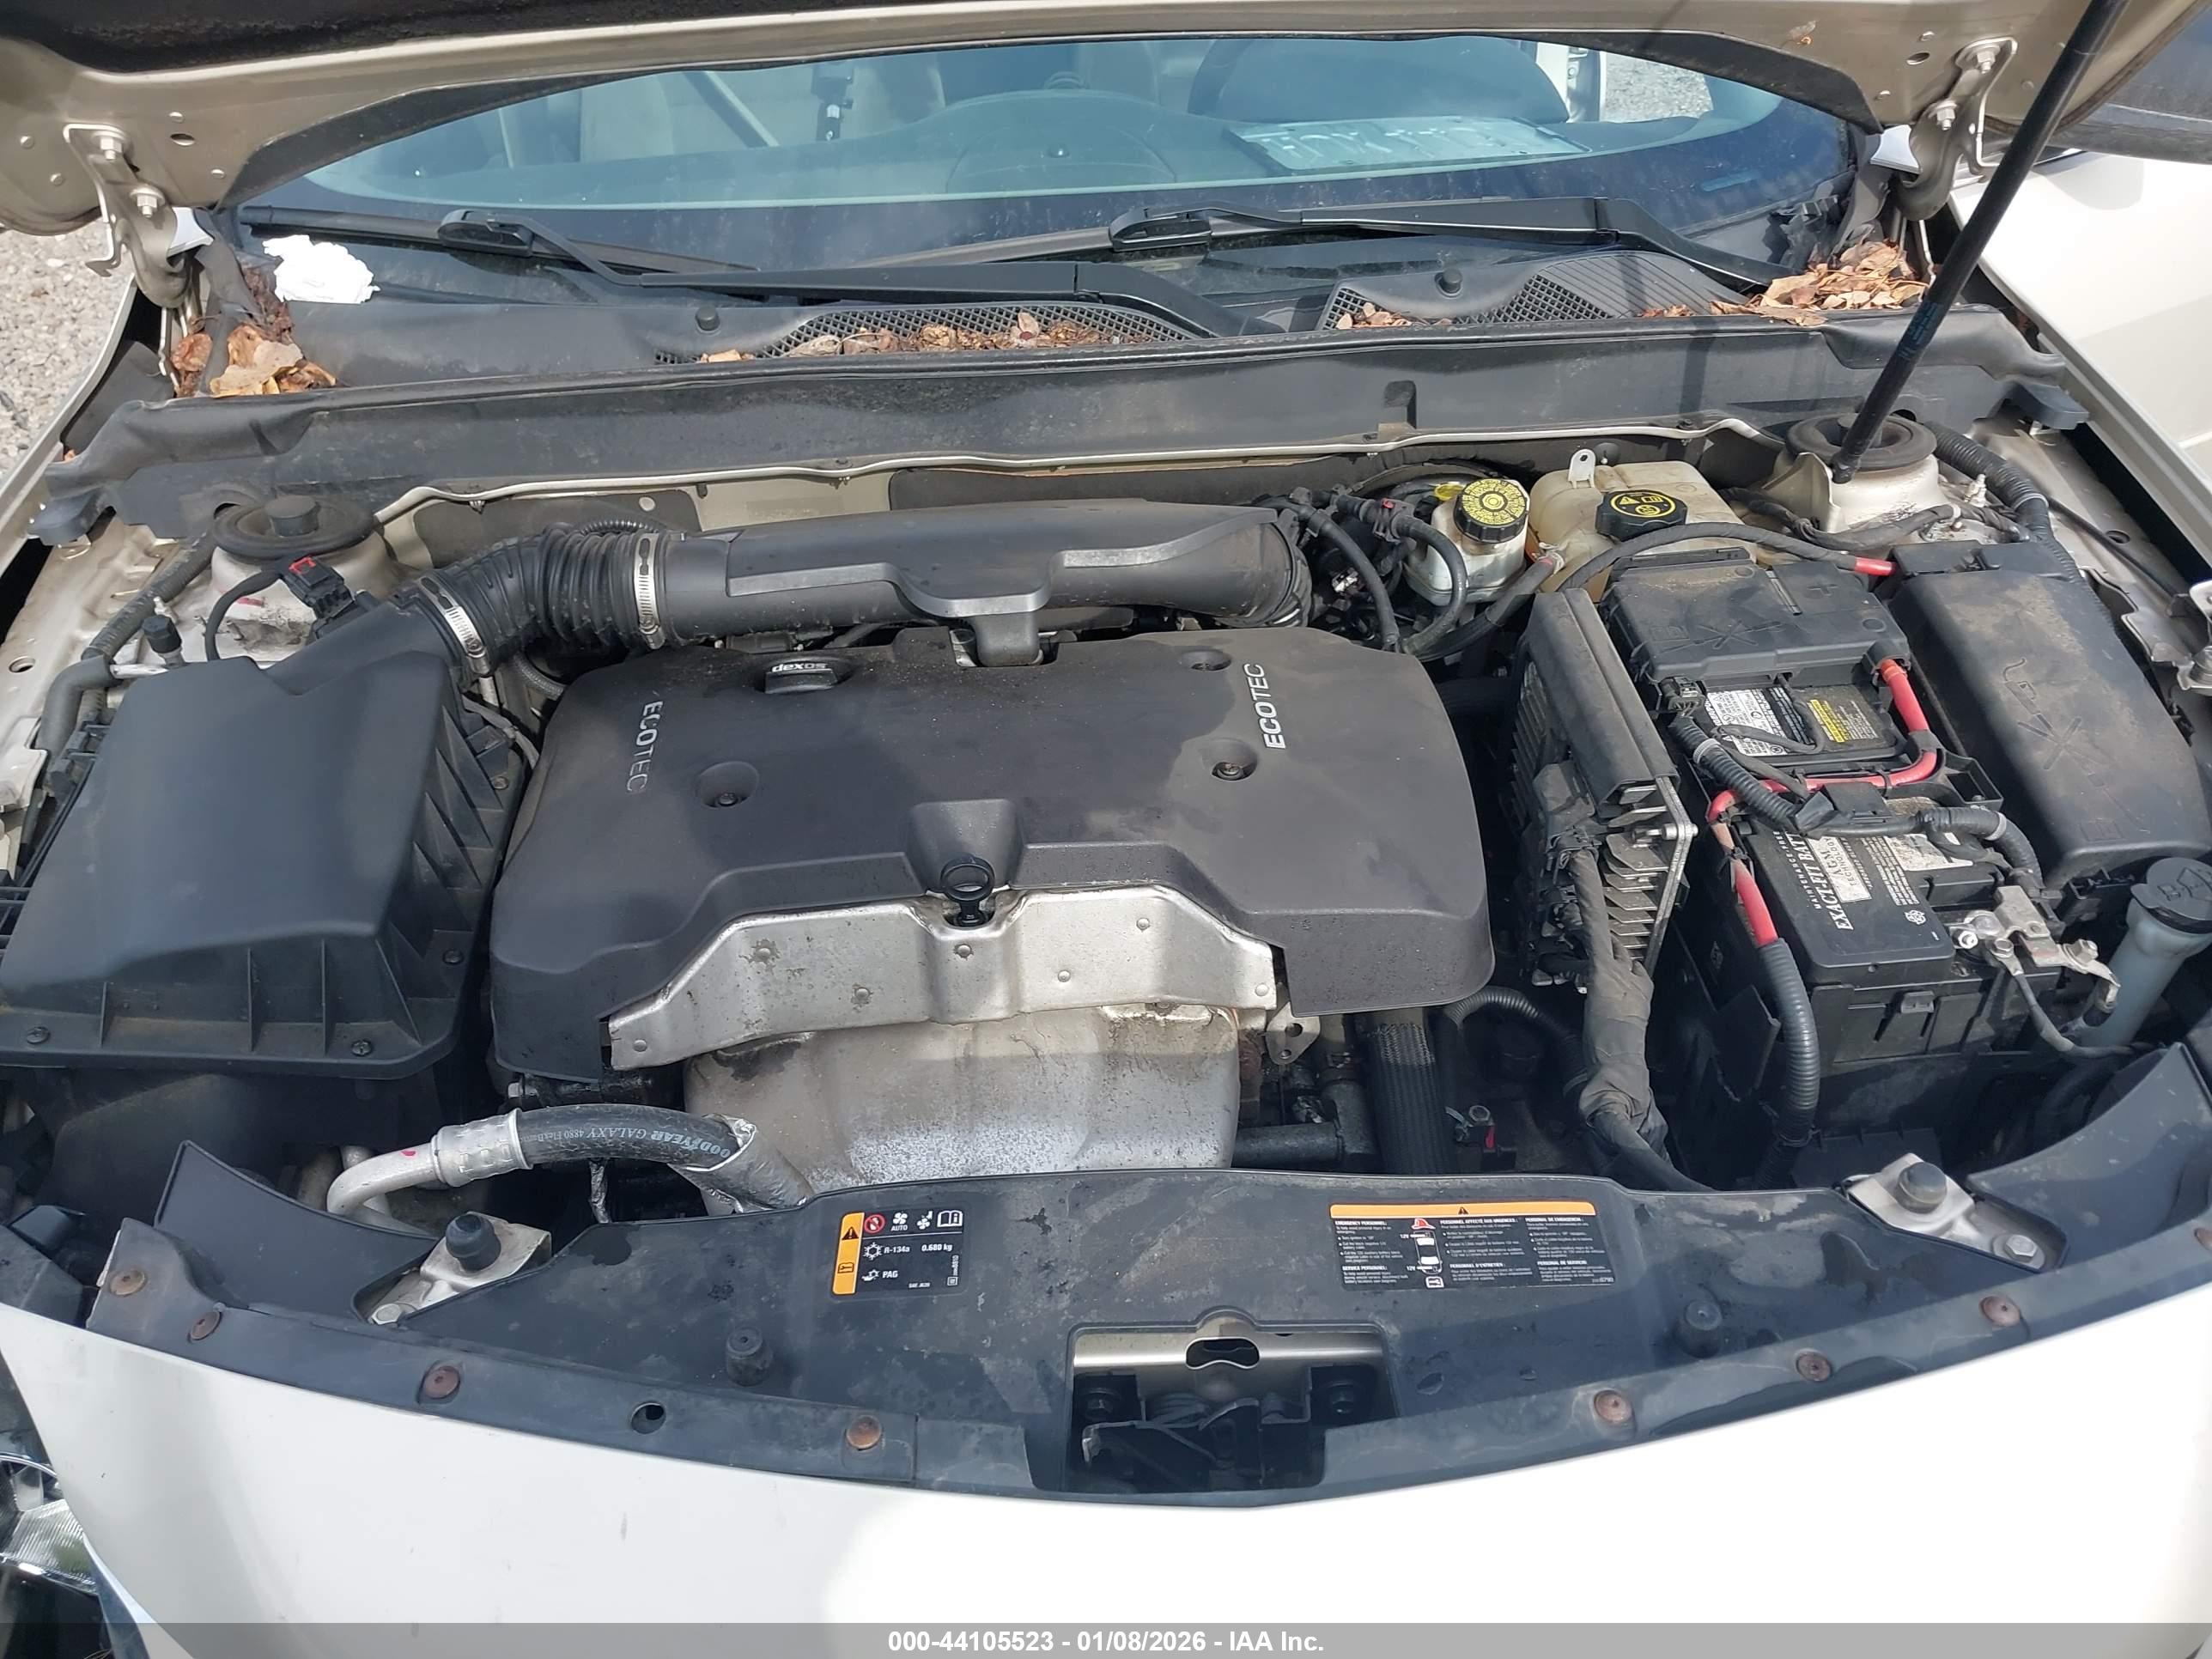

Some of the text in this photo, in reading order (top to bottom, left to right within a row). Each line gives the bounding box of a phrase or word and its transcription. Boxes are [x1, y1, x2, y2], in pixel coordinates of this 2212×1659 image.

[772, 663, 828, 672] dexos
[1244, 663, 1286, 749] ECOTEC
[627, 701, 664, 792] ECOTEC
[1820, 851, 1844, 876] AGM
[1823, 837, 1856, 886] TECHNOLOGY
[1785, 830, 1854, 930] EXACT-FIT BATT
[564, 1128, 585, 1139] 4880
[586, 1127, 647, 1139] GALAXY
[884, 1245, 910, 1254] R-134a
[943, 1243, 953, 1252] kg
